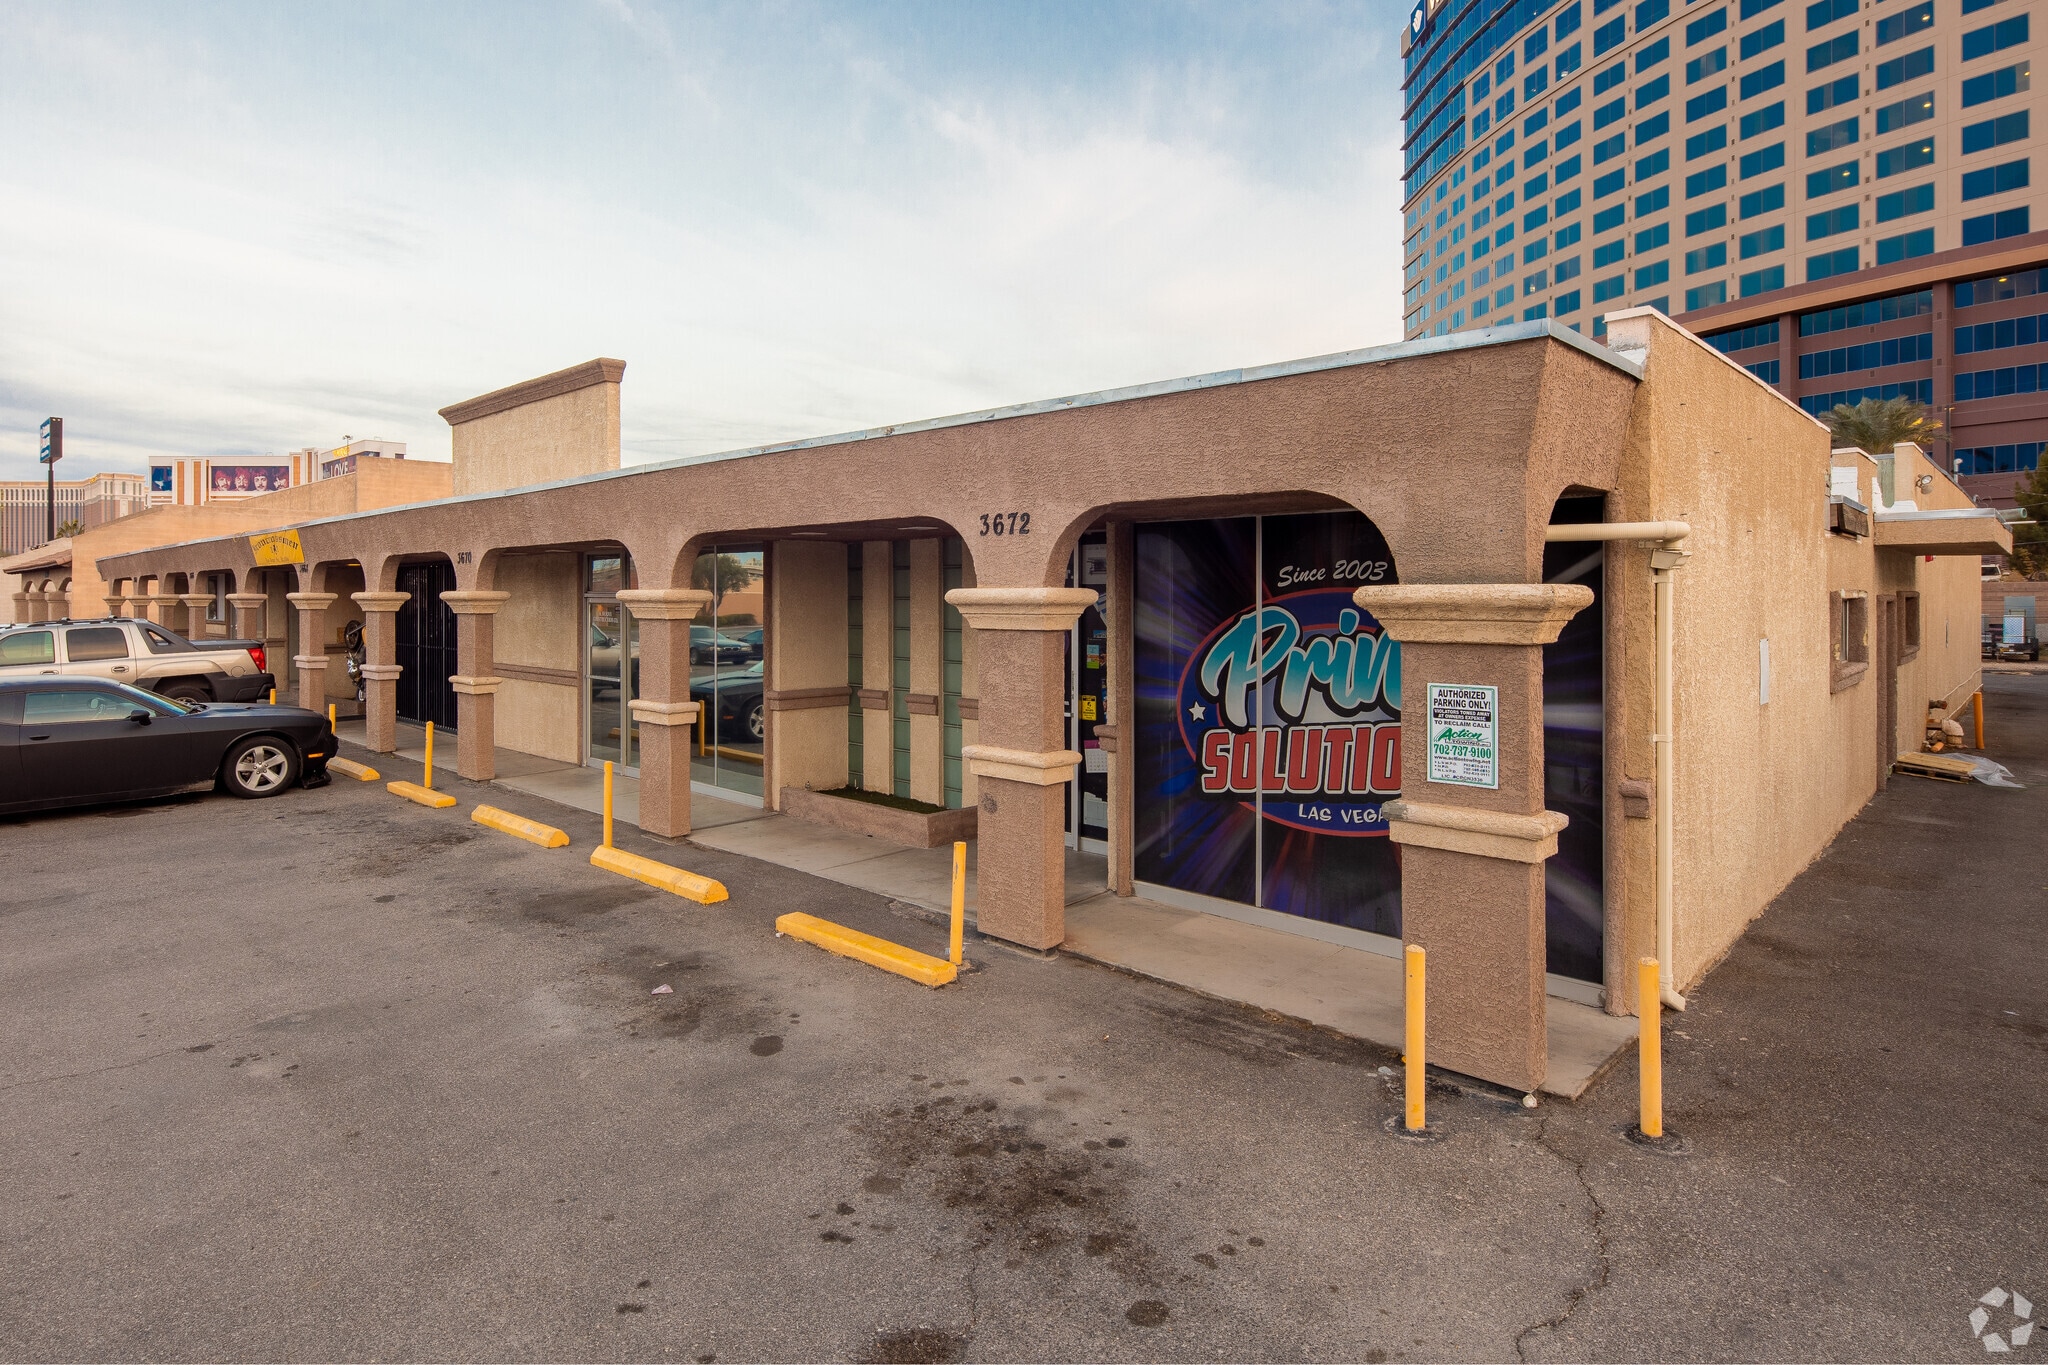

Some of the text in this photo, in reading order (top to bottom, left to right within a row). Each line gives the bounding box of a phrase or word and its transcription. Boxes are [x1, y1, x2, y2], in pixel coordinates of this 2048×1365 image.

[330, 461, 349, 478] LOVE
[980, 512, 1030, 536] 3672
[1277, 559, 1388, 588] Since 2003
[1201, 606, 1401, 727] Prin
[1438, 689, 1486, 700] AUTHORIZED
[1433, 698, 1491, 710] PARKING ONLY!
[1436, 727, 1486, 741] Action
[1203, 723, 1401, 794] SOLUTIO
[1433, 743, 1491, 759] 702-737-9100
[1298, 803, 1332, 821] LAS
